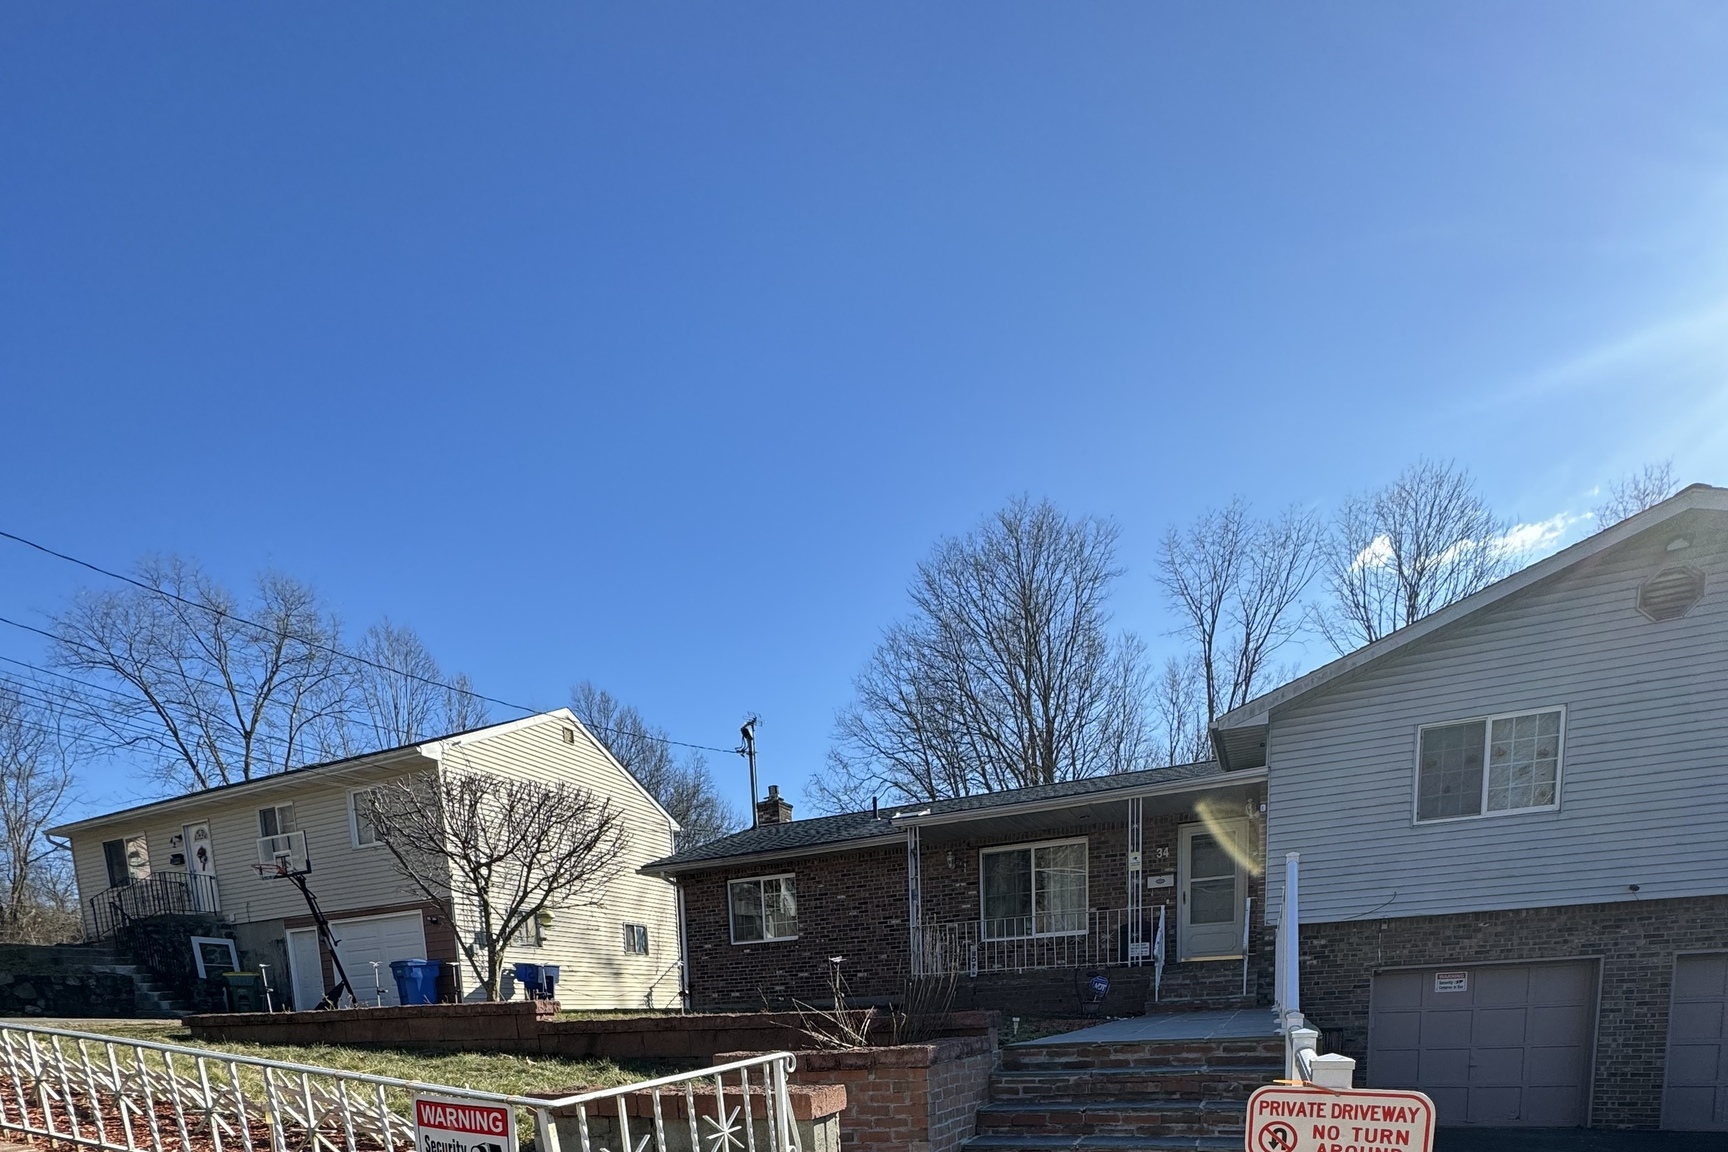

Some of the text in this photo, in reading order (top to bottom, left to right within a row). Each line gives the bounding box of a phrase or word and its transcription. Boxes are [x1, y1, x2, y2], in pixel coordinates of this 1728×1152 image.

[1156, 847, 1169, 858] 34
[1093, 982, 1107, 991] ADT
[420, 1104, 503, 1133] WARNING
[1258, 1100, 1421, 1123] PRIVATE DRIVEWAY
[1312, 1125, 1410, 1145] NO TURN
